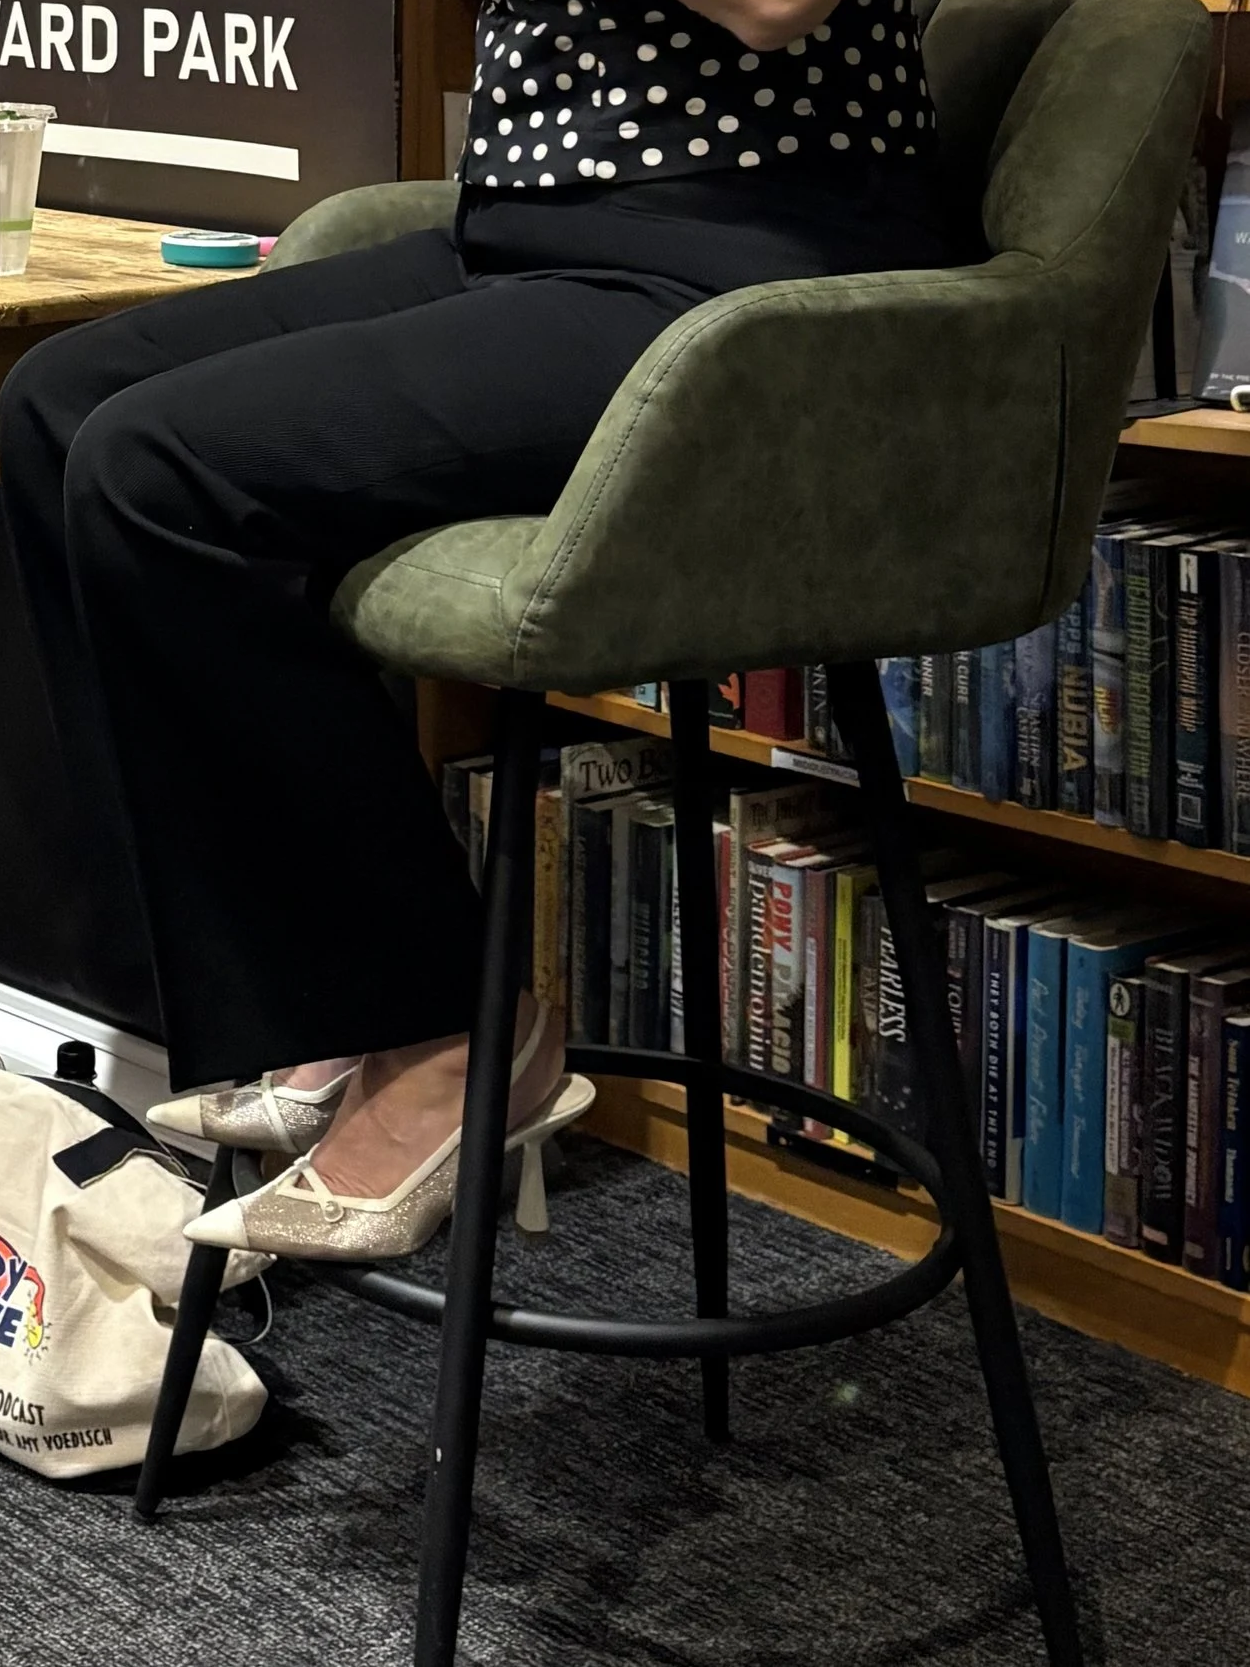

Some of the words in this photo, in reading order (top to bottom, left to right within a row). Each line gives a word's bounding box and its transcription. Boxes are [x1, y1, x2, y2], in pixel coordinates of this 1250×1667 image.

[143, 8, 299, 92] PARK
[957, 664, 969, 704] CURE
[1061, 664, 1088, 771] NUBIA
[579, 756, 633, 792] TWO
[771, 882, 792, 952] PONY
[771, 962, 792, 1075] PALACIO
[989, 1011, 999, 1049] BOTH
[988, 1055, 999, 1077] DIE
[988, 1084, 999, 1102] AT
[988, 1109, 999, 1132] THE
[987, 1140, 998, 1169] END
[16, 1433, 40, 1454] AMY
[43, 1427, 113, 1452] VOEDISCH
